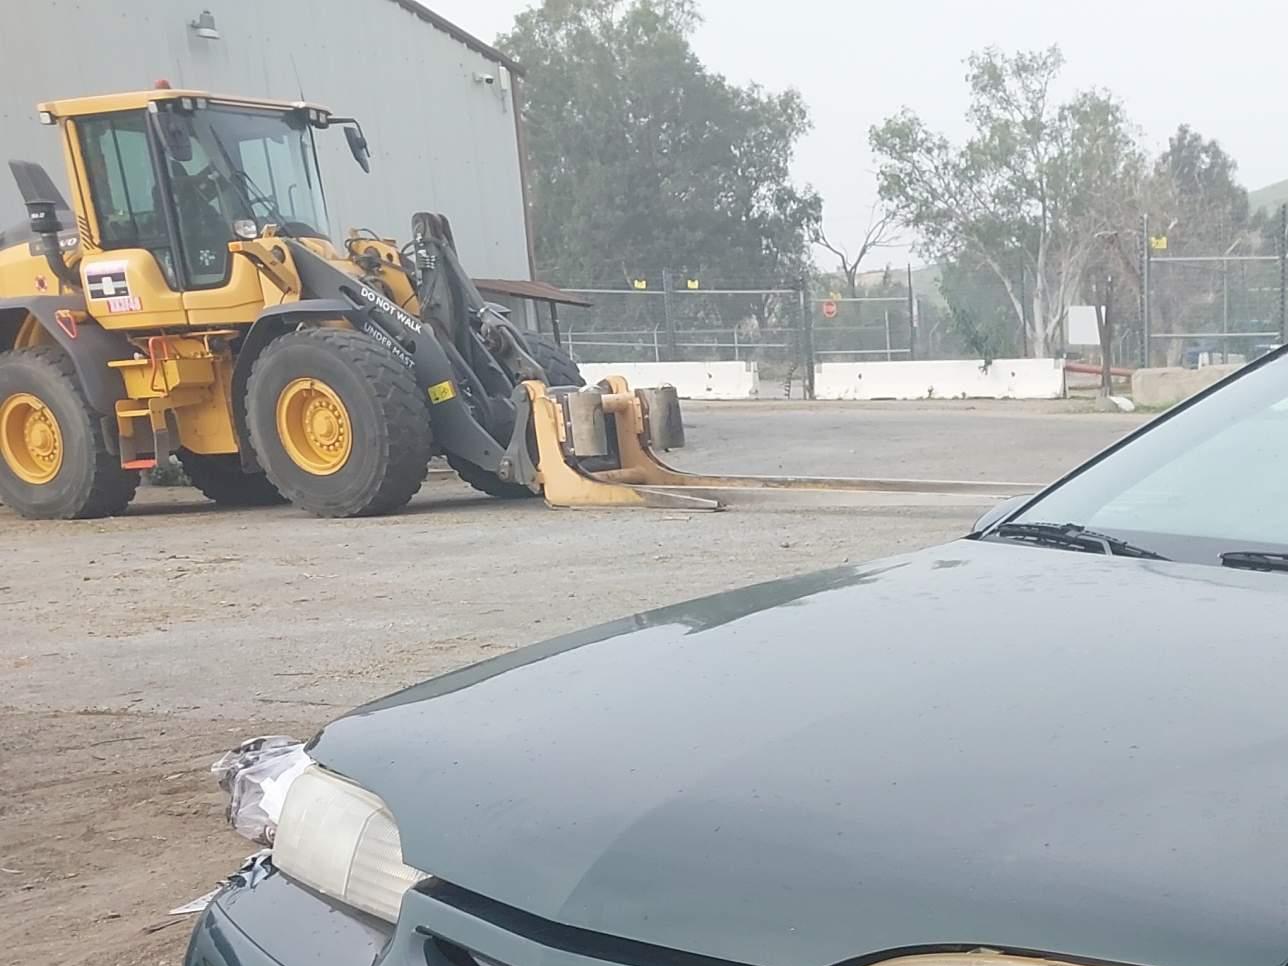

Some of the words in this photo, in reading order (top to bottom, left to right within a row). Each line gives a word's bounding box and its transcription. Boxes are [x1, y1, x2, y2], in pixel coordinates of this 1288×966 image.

[360, 287, 376, 302] DO
[375, 297, 397, 315] NOT
[396, 311, 422, 335] WALK
[363, 322, 392, 349] UNDER
[392, 346, 415, 369] MAST
